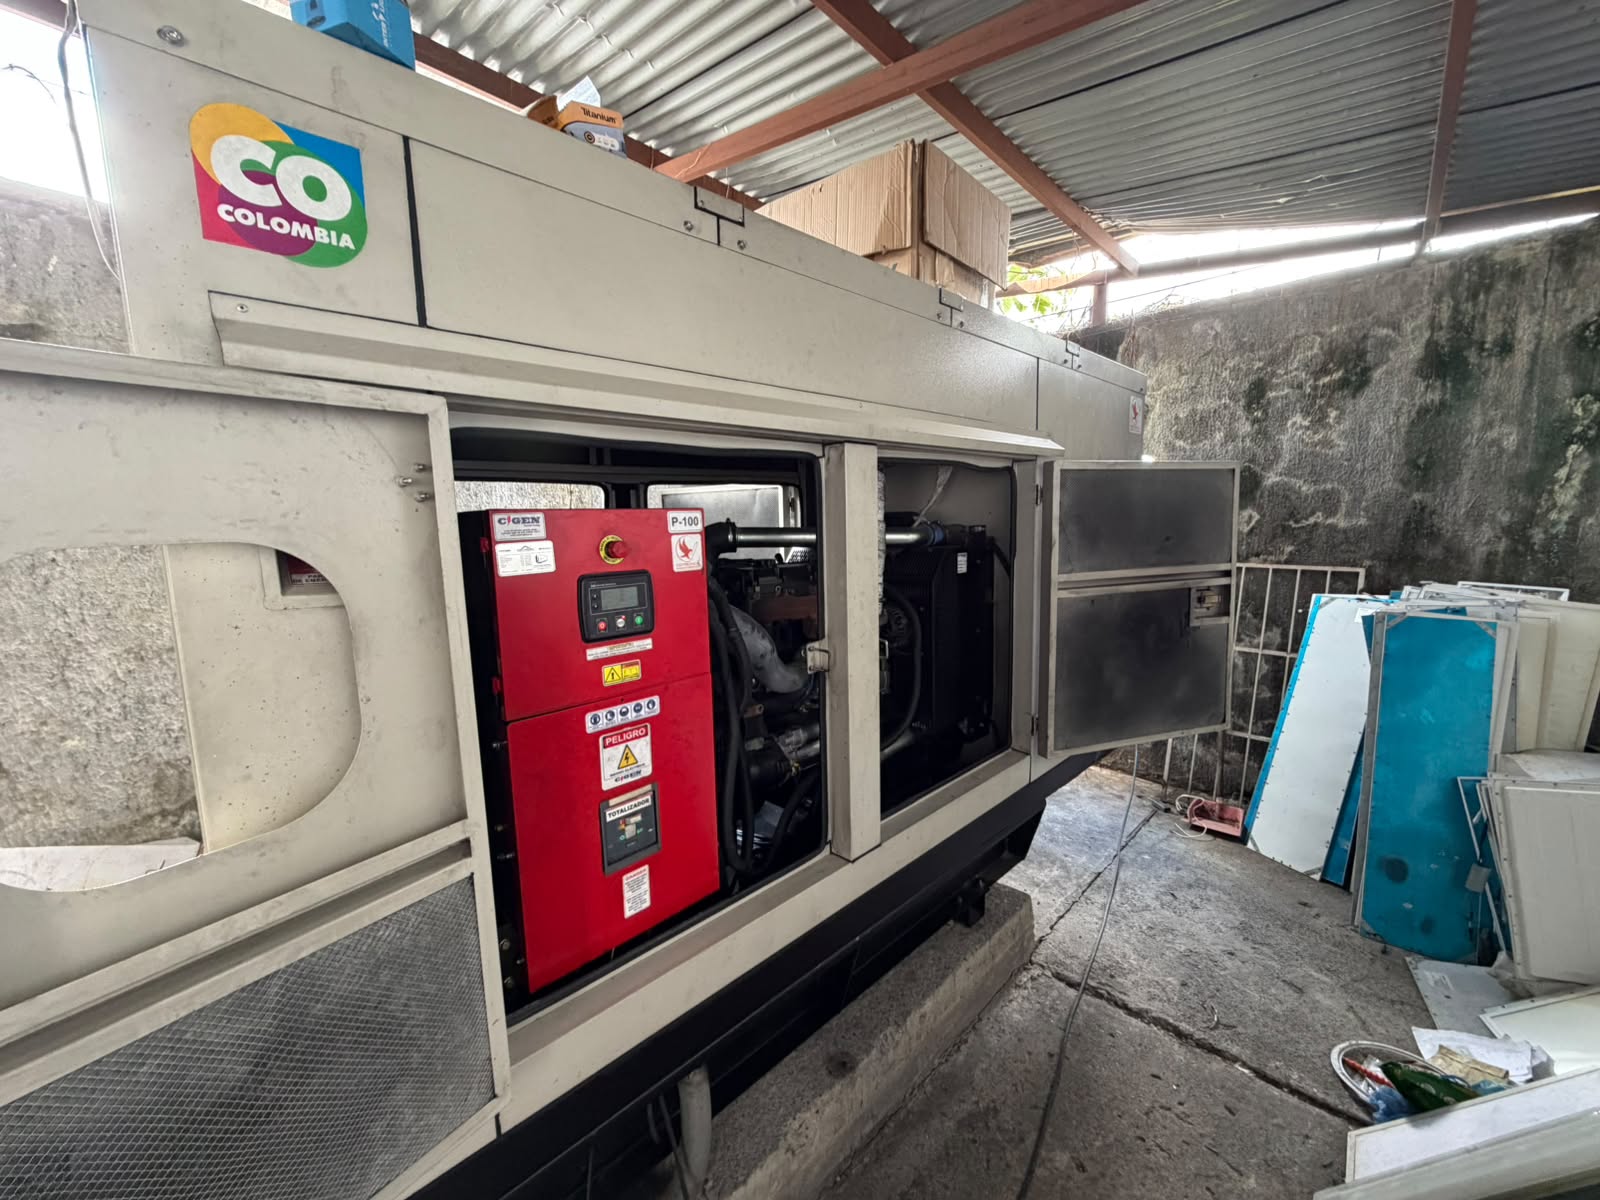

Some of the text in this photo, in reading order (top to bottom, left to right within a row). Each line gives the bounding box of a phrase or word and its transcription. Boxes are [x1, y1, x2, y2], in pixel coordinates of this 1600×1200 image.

[580, 106, 616, 124] Titanium
[210, 134, 353, 222] CO
[217, 203, 356, 250] COLOMBIA
[671, 516, 699, 527] P-100
[605, 727, 646, 746] PELIGRO
[608, 798, 650, 818] TOTALIZADOR
